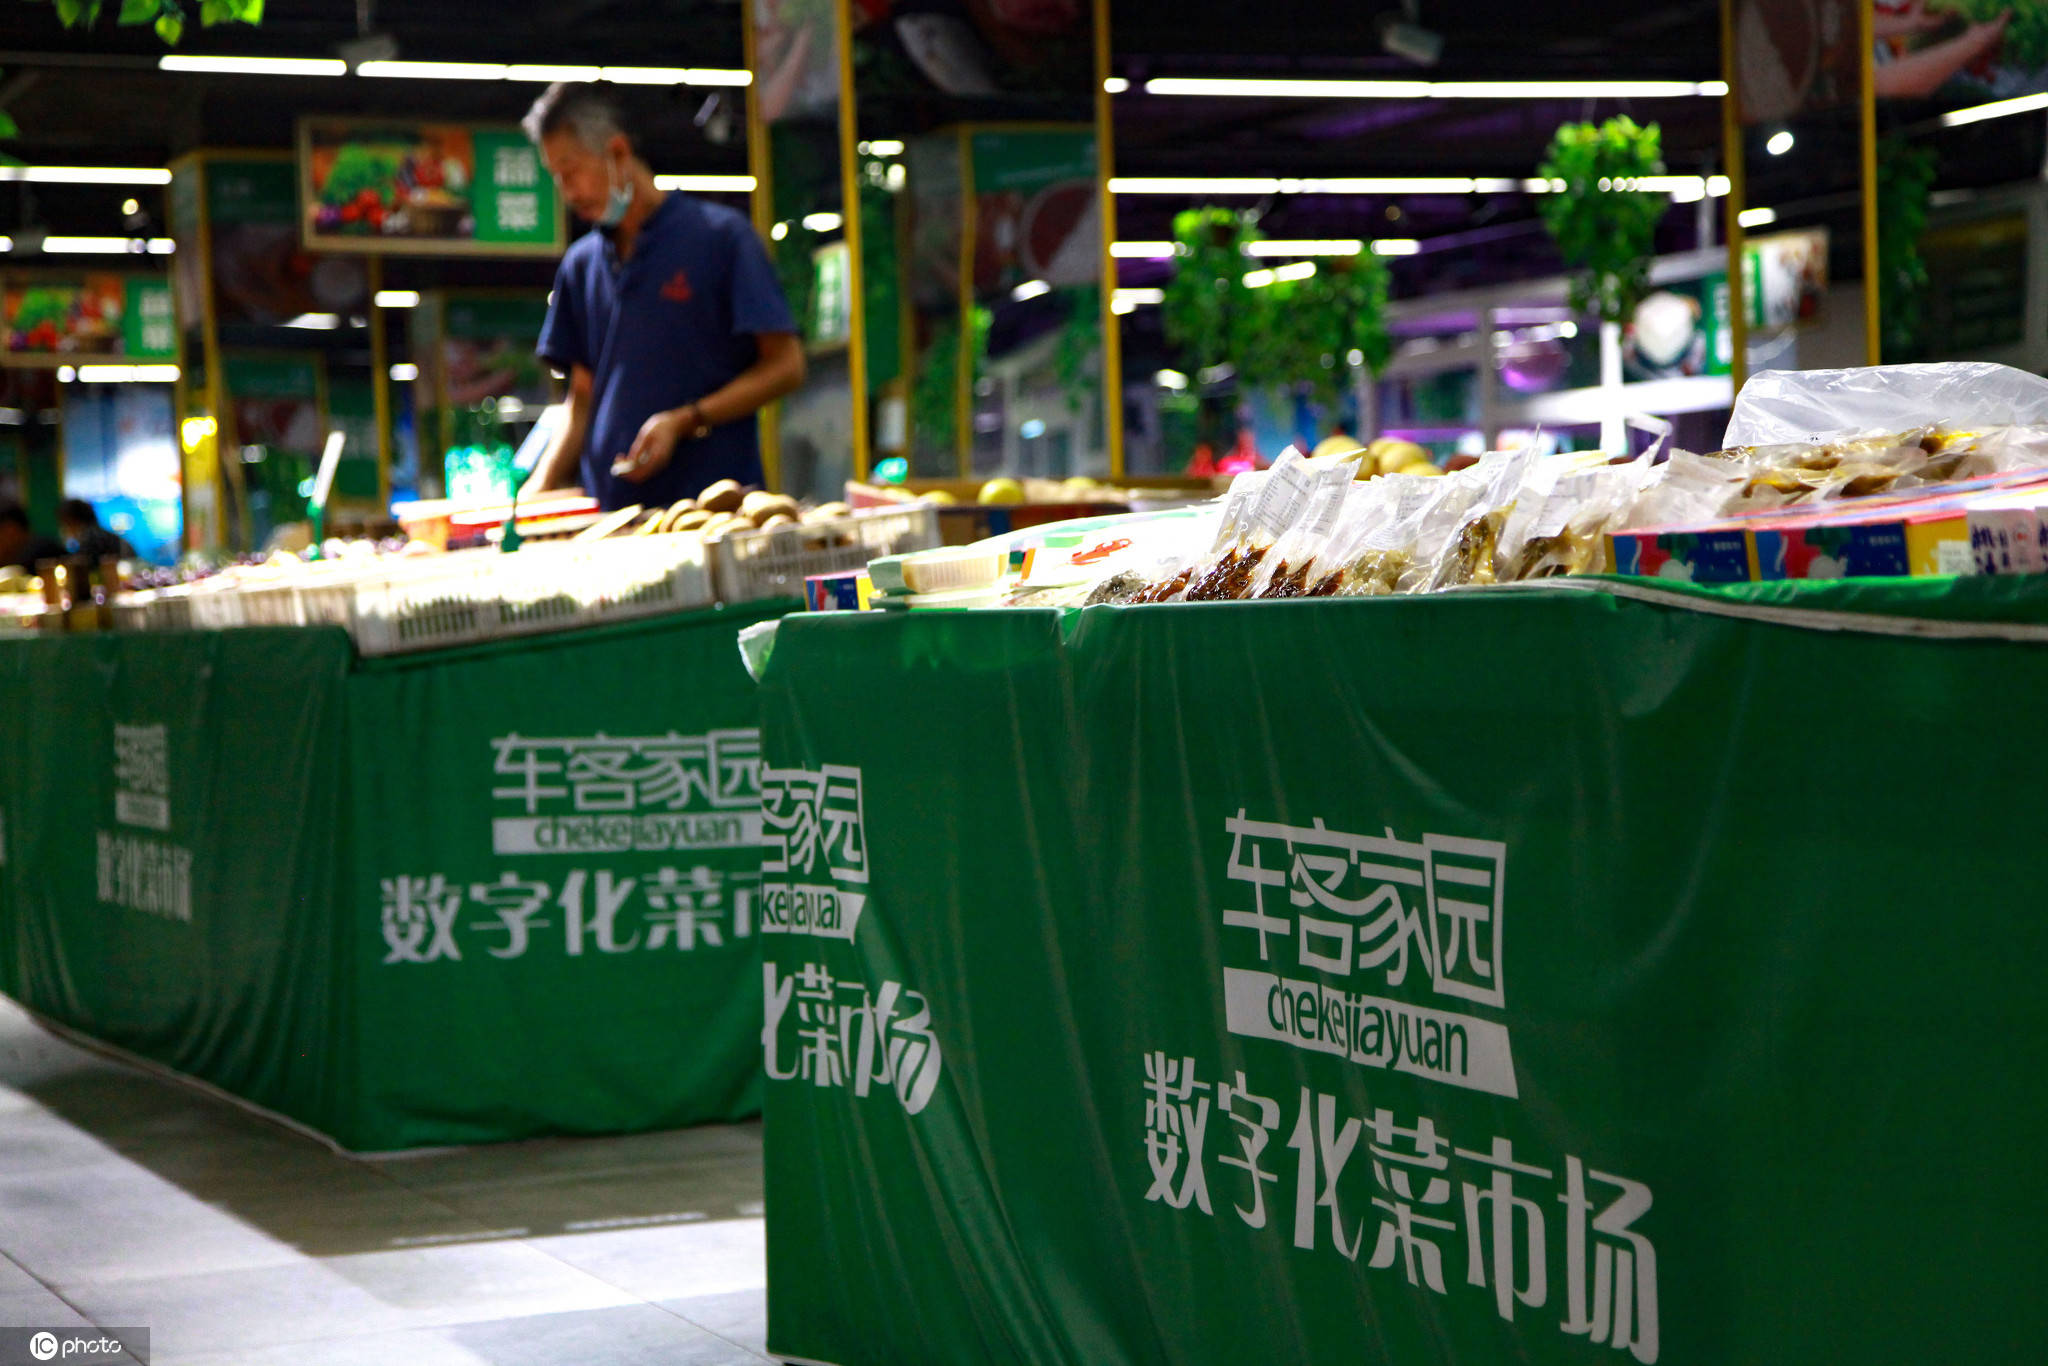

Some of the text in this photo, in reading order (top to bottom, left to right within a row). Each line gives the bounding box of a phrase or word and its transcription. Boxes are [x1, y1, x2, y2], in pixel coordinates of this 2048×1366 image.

[490, 727, 761, 814] 车客家园
[1222, 808, 1506, 1009] 车客家园
[1267, 976, 1468, 1076] chekejiayuan
[1143, 1050, 1660, 1365] 数字化菜市场
